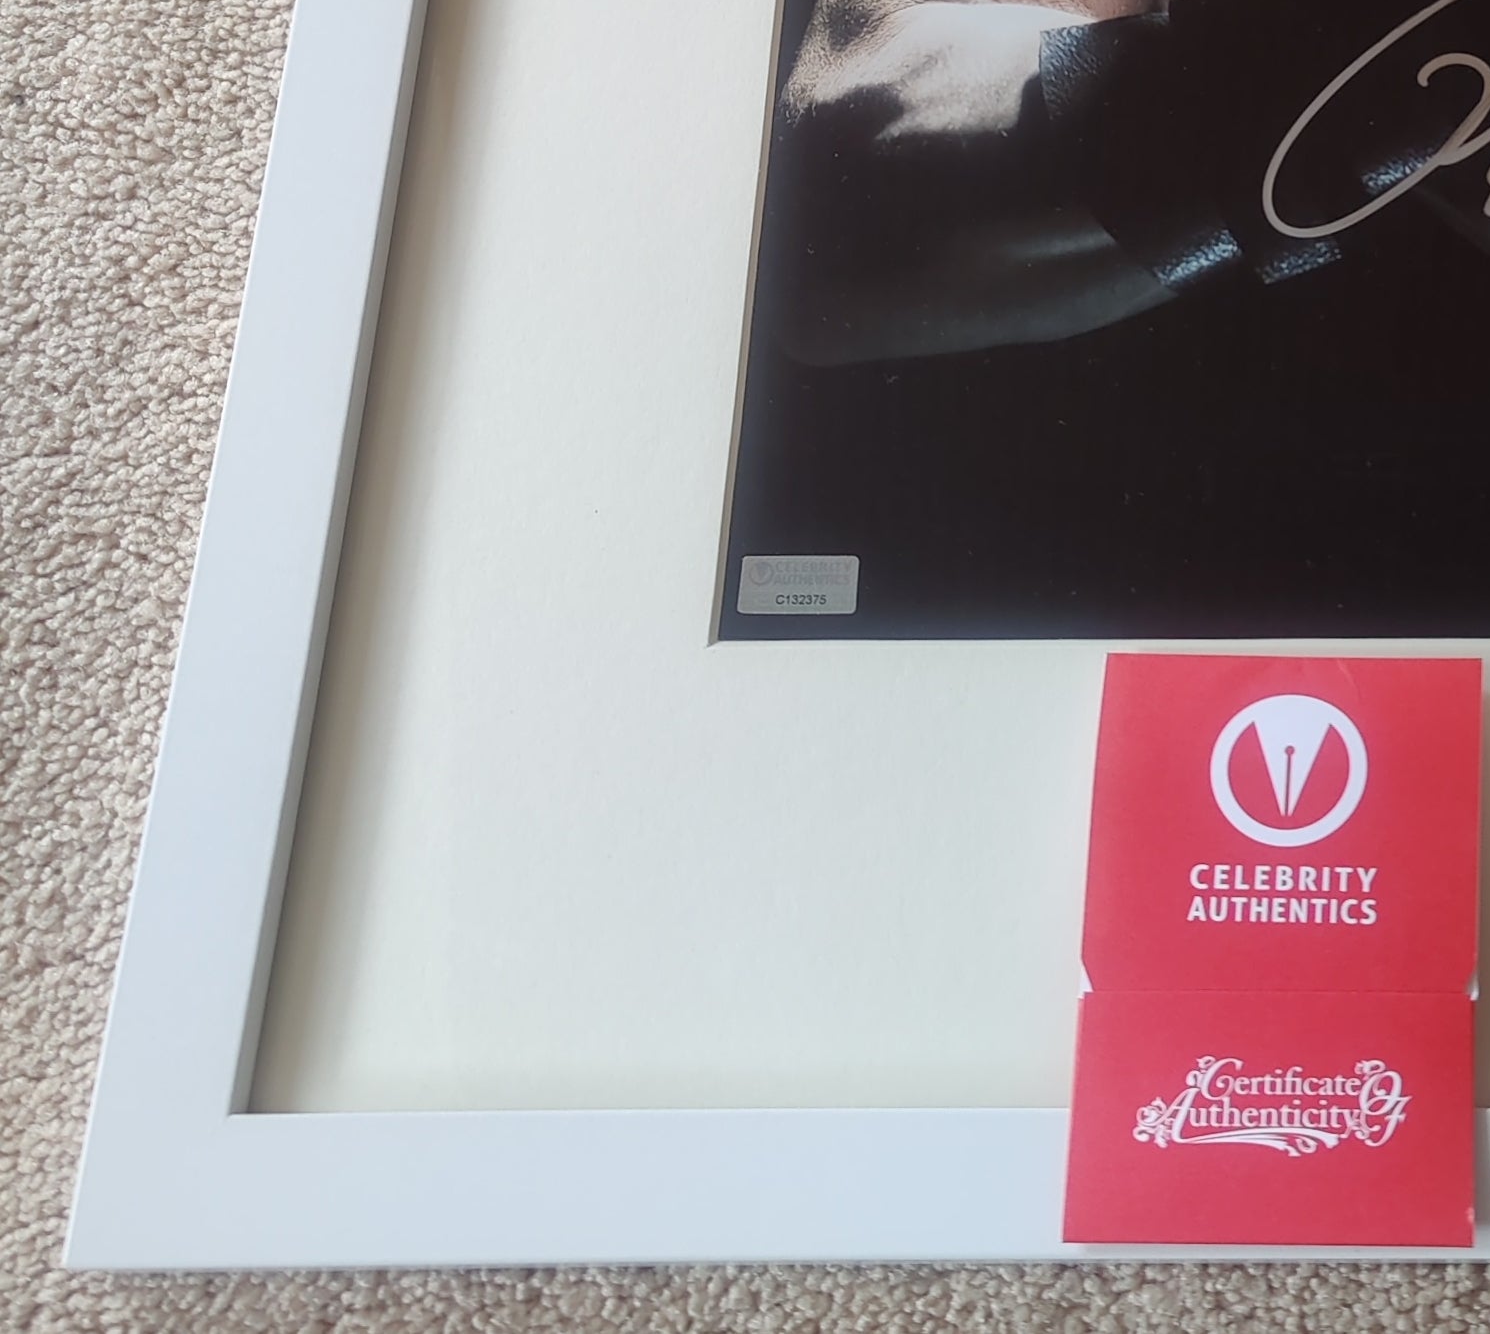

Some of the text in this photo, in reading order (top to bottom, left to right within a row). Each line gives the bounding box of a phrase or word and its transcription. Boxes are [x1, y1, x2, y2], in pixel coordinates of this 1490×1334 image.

[775, 594, 827, 605] C132375
[1189, 864, 1378, 893] CELEBRITY
[1186, 896, 1378, 926] AUTHENTICS
[1187, 1056, 1361, 1100] Certificate
[1134, 1088, 1358, 1148] Authenticity
